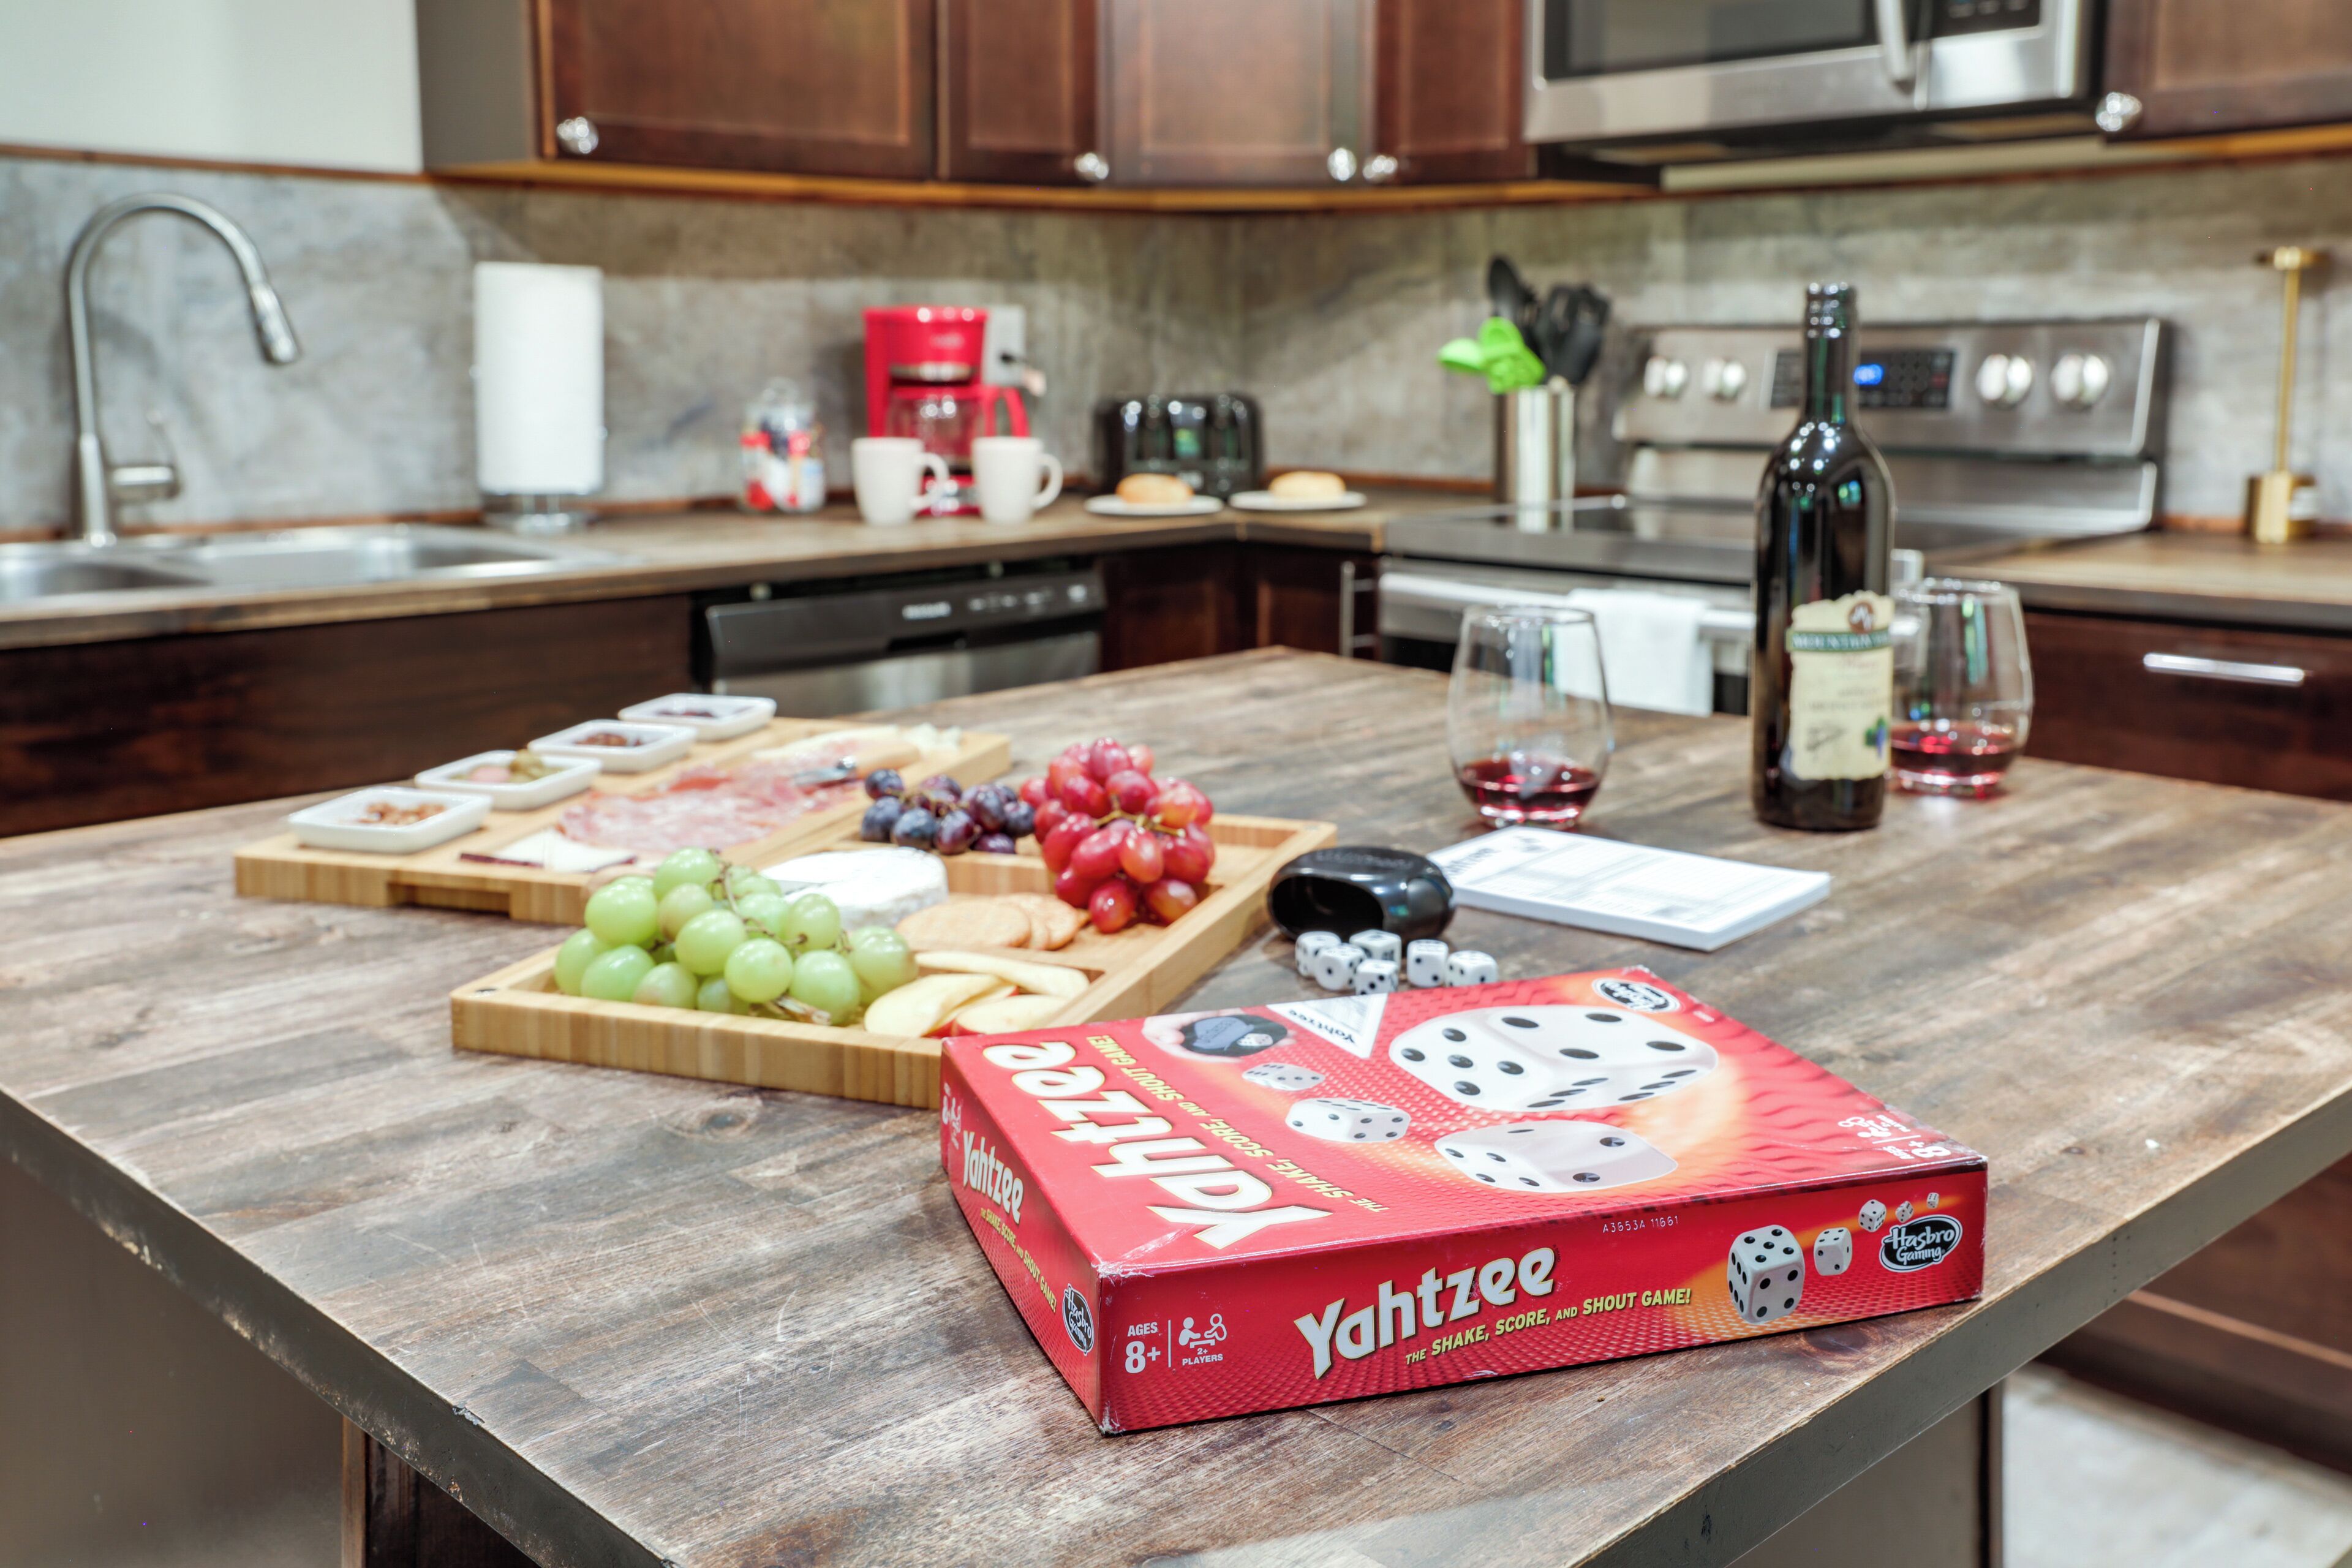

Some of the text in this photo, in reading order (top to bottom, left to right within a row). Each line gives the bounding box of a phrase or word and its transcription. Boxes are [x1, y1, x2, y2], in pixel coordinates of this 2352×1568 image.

[1086, 1035, 1391, 1213] THE SHAKE, SCORE, AND SHOUT GAME!
[982, 1041, 1333, 1250] Yahtzee
[1908, 1140, 1951, 1158] 8+
[962, 1129, 1024, 1224] Yahtzee
[1602, 1219, 1646, 1234] A3653A
[1883, 1226, 1955, 1251] Hasbro
[986, 1208, 1001, 1234] SHAKE,
[1001, 1223, 1017, 1251] SCORE,
[1023, 1250, 1041, 1283] SHOUT
[1040, 1276, 1057, 1313] GAME!
[1896, 1246, 1943, 1265] Gaming
[1065, 1286, 1091, 1339] Hasbro
[1069, 1311, 1087, 1353] Gaming
[1127, 1322, 1158, 1337] AGES
[1294, 1247, 1555, 1379] Yahtzee
[1405, 1287, 1691, 1365] THE SHAKE, SCORE, AND SHOUT GAME!
[1125, 1341, 1161, 1374] 8+
[1182, 1353, 1224, 1366] PLAYERS
